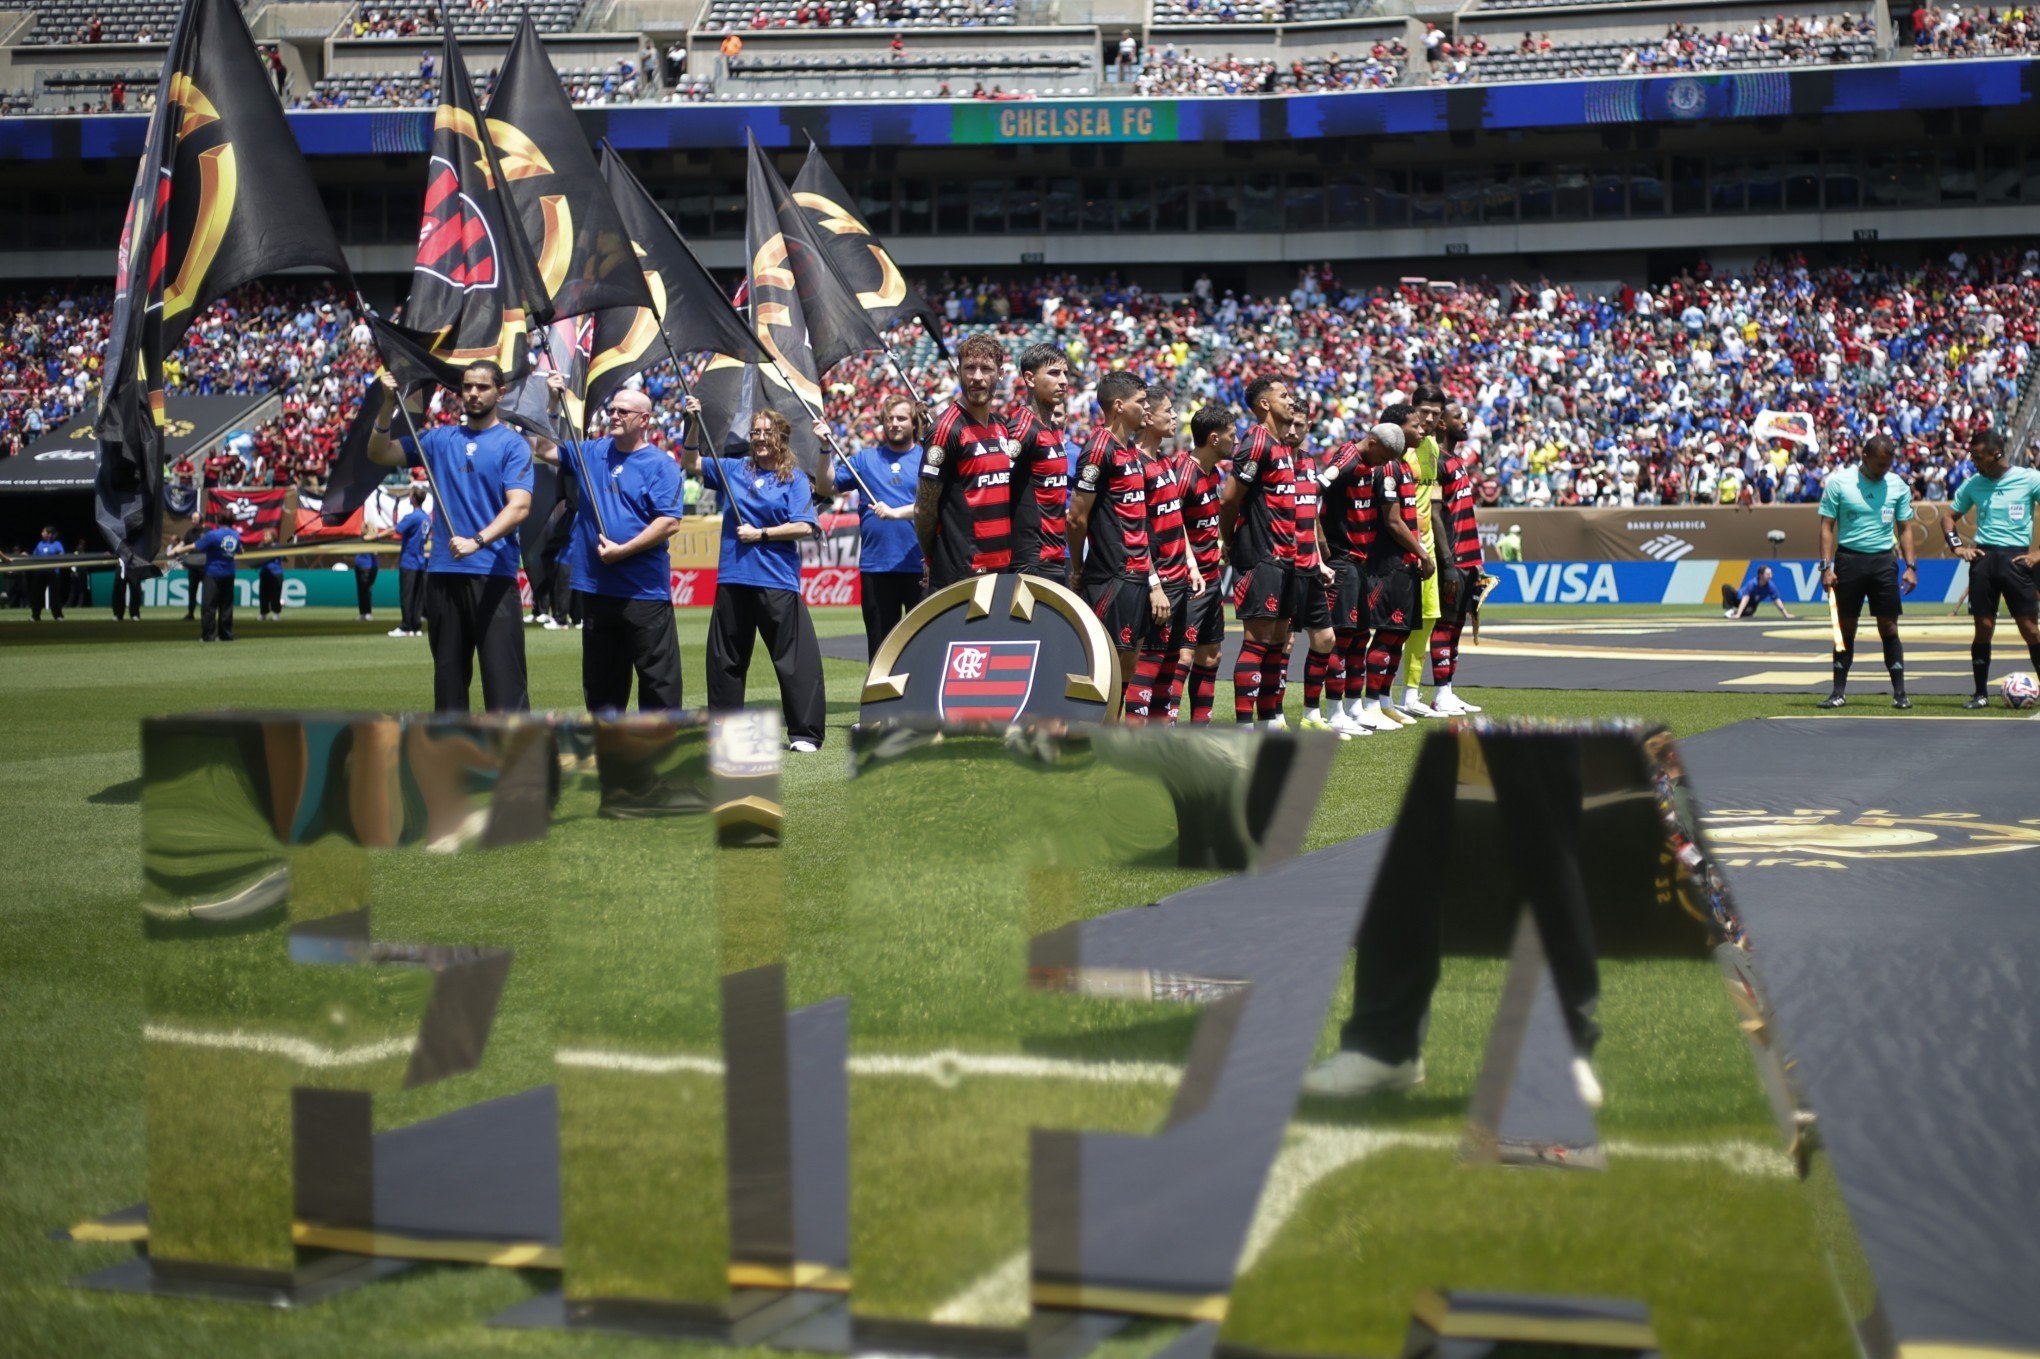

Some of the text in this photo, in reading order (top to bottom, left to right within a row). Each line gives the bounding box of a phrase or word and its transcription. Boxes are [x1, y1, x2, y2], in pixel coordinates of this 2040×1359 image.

[1001, 107, 1152, 137] CHELSEA FC
[978, 472, 1010, 487] FLABE
[1044, 475, 1067, 487] FLAB
[1627, 521, 1706, 530] BANK OF AMERICA
[1506, 564, 1619, 602] VISA
